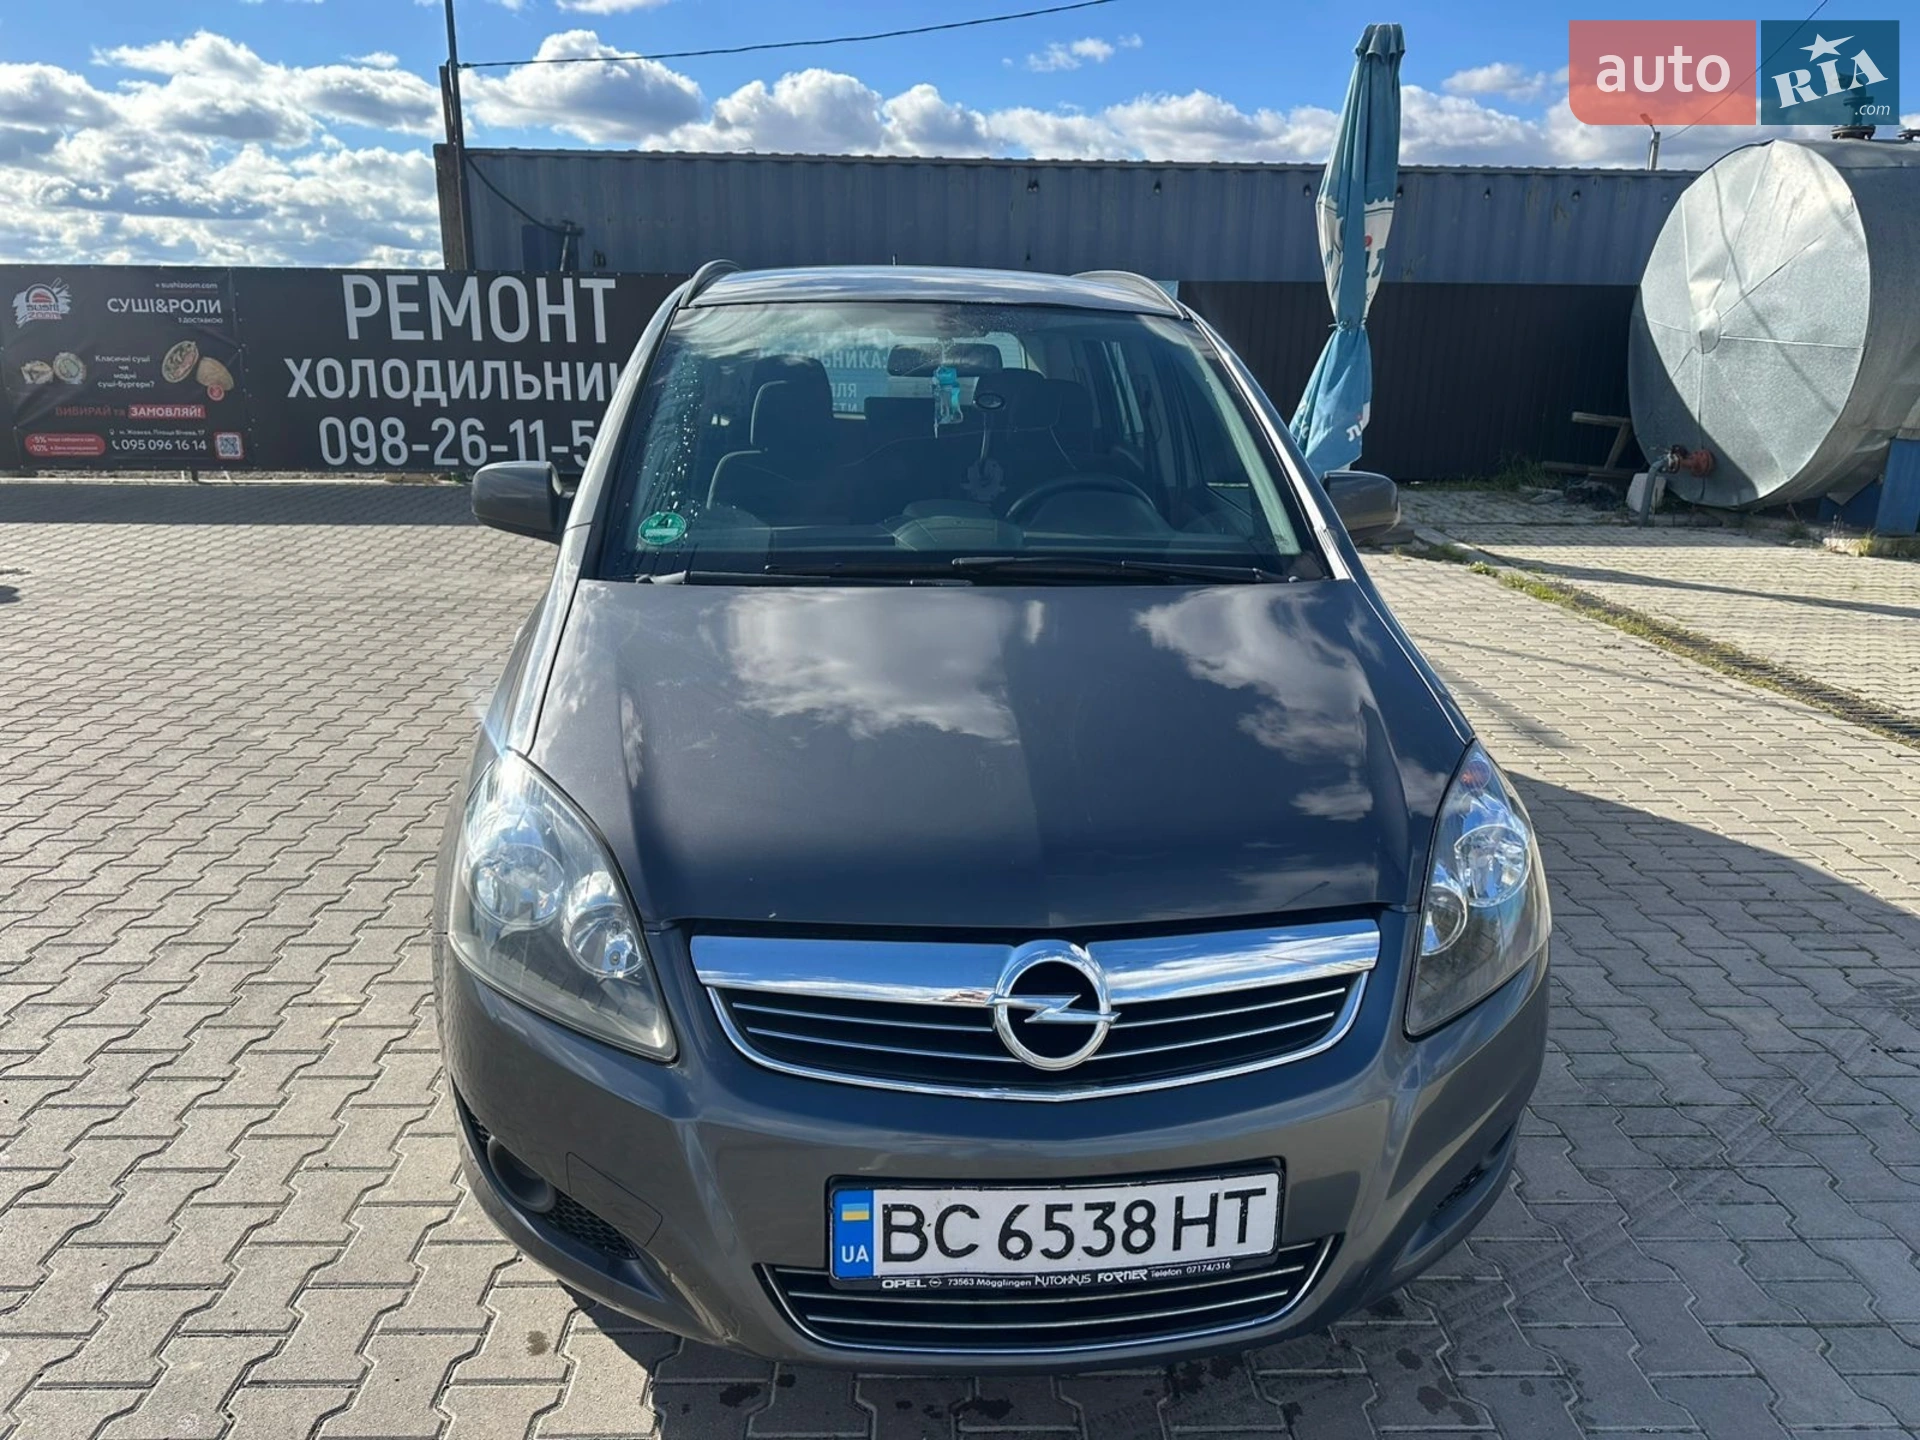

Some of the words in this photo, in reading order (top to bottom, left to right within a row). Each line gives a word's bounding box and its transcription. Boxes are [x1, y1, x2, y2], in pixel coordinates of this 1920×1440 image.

[107, 298, 222, 314] СУШІ&РОЛИ
[342, 274, 616, 344] РЕМОНТ
[130, 405, 201, 417] ЗАМОВЛЯЙ!
[121, 439, 146, 450] 095
[148, 439, 173, 450] 096
[175, 439, 190, 450] 16
[192, 439, 207, 450] 14
[881, 1203, 980, 1263] BC
[999, 1198, 1158, 1261] 6538
[1172, 1187, 1267, 1252] HT
[841, 1247, 869, 1264] UA
[881, 1279, 927, 1289] OPEL
[948, 1278, 974, 1287] 73563
[976, 1277, 1032, 1288] Mögglingen
[1151, 1267, 1182, 1278] Telefon
[1186, 1262, 1231, 1275] 07174/316
